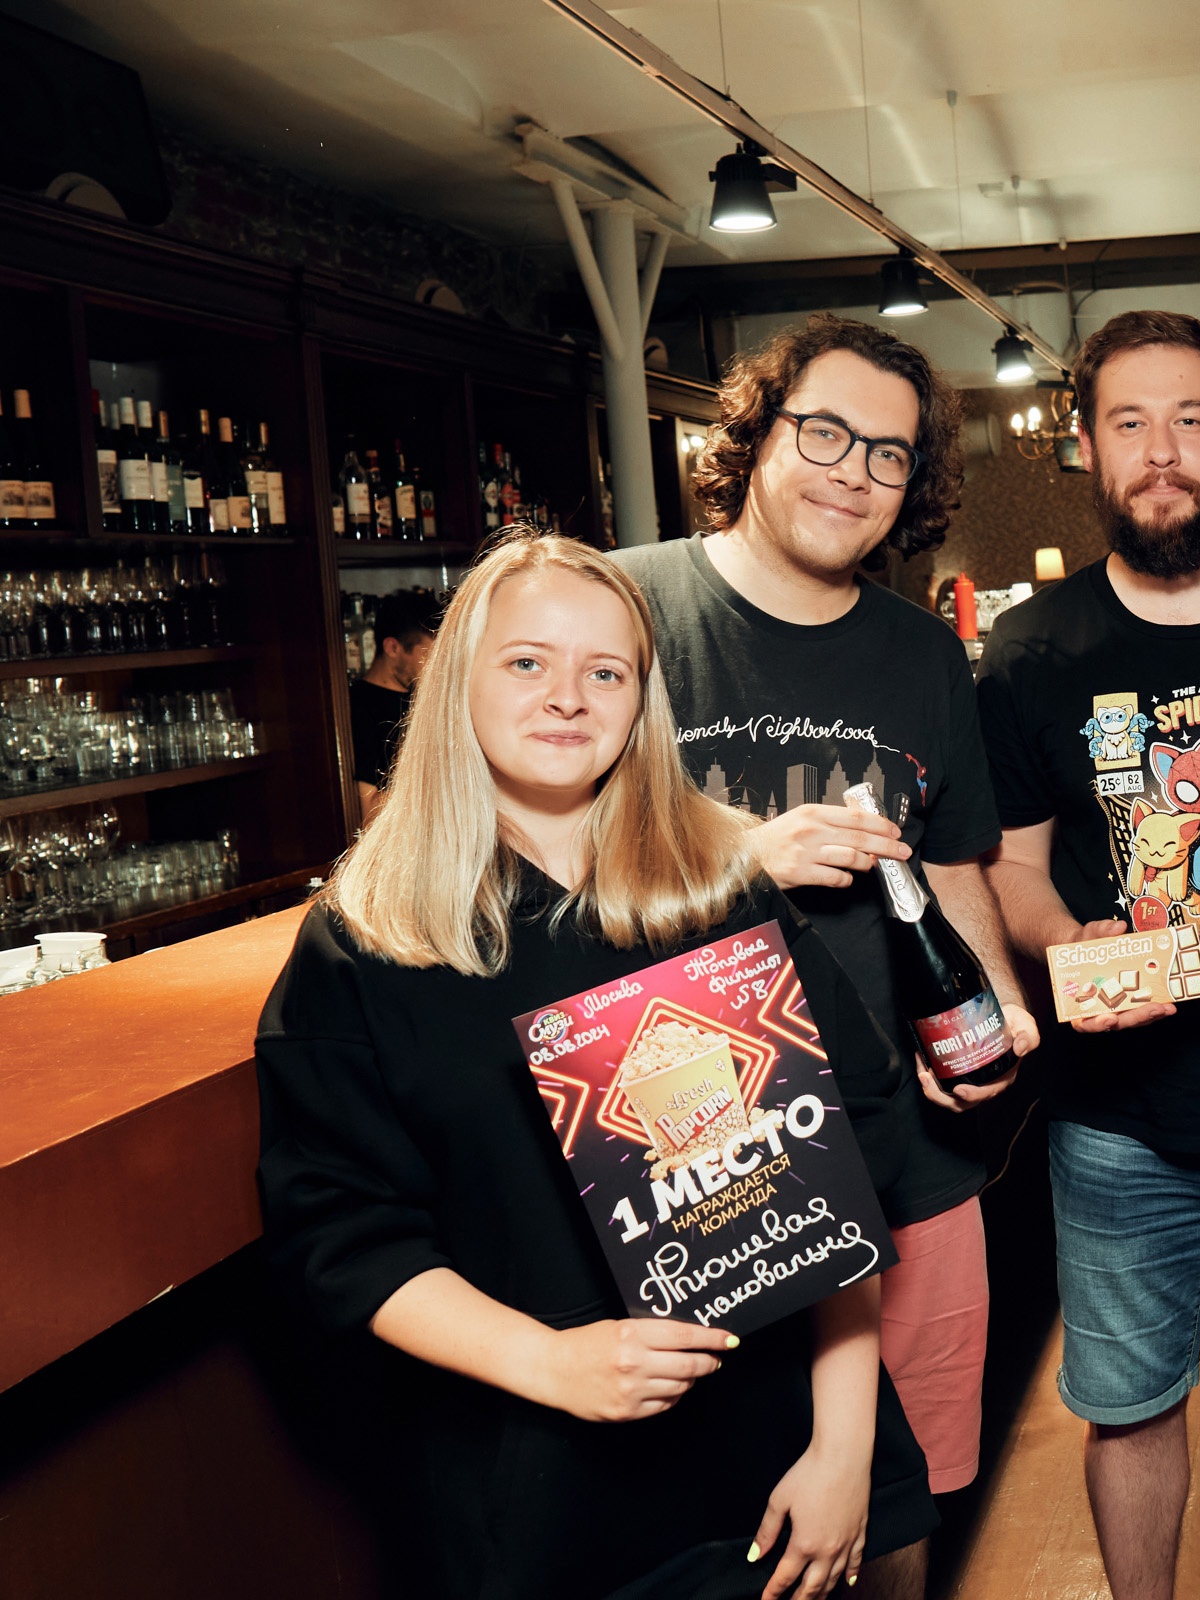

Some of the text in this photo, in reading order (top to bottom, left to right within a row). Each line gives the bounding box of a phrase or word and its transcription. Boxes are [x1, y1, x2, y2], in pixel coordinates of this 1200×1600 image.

[1172, 686, 1196, 698] THE
[675, 714, 875, 745] iendly Neighborhood
[1100, 777, 1121, 792] 25¢
[1127, 773, 1139, 784] 62
[894, 879, 905, 891] DI
[1056, 936, 1152, 967] Schogetten
[583, 979, 644, 1019] Москва
[528, 1015, 574, 1042] Смузи
[543, 1011, 565, 1026] КВИЗ
[932, 1035, 963, 1056] FIORI
[962, 1029, 977, 1047] DI
[974, 1012, 1001, 1040] MARE
[529, 1023, 611, 1066] 08.08.2024
[612, 1094, 825, 1244] 1 МЕСТО
[671, 1153, 792, 1234] НАГРАЖДАЕТСЯ
[698, 1182, 778, 1237] КОМАНДА
[639, 1196, 836, 1317] Плюшевая
